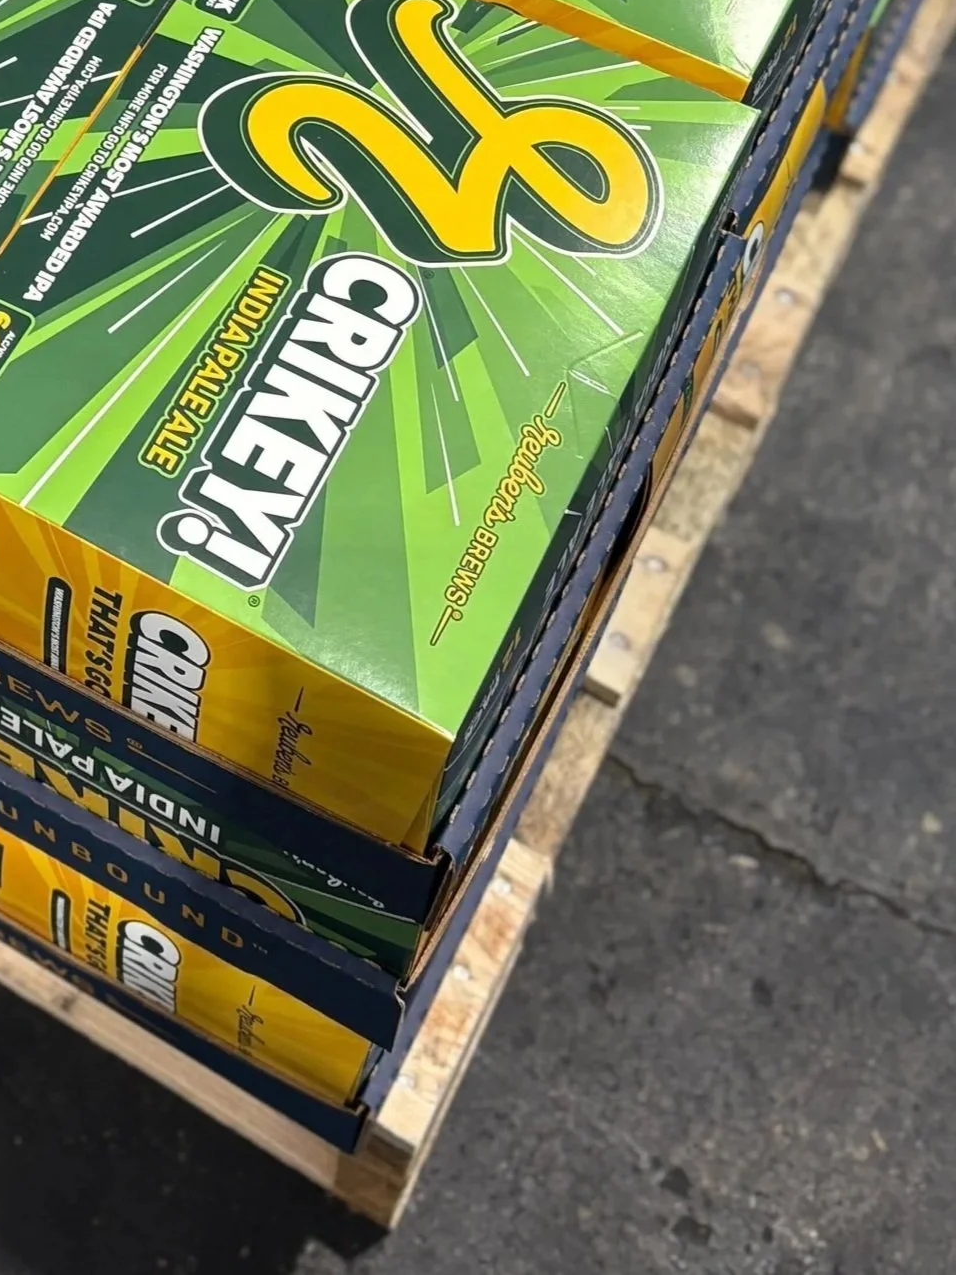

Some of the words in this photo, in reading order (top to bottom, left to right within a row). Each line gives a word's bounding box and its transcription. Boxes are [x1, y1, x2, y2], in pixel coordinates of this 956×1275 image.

[2, 100, 45, 152] MOST
[36, 26, 97, 106] AWARDED
[88, 2, 117, 30] IPA
[127, 83, 154, 111] MORE
[131, 27, 223, 148] WASHINGTON'S
[148, 63, 168, 86] FOR
[7, 156, 31, 186] INFO
[28, 139, 42, 159] GO
[37, 126, 52, 146] TO
[46, 56, 103, 130] CRIKEYIPA.COM
[94, 146, 110, 165] TO
[105, 132, 120, 151] GO
[113, 107, 137, 136] INFO
[40, 161, 99, 241] CRIKEYIPA.COM
[100, 142, 143, 192] MOST
[46, 187, 110, 273] AWARDED
[23, 270, 56, 301] IPA
[220, 270, 285, 346] INDIA
[178, 343, 241, 416] PALE
[145, 408, 196, 472] ALE
[167, 254, 420, 586] CRIKEY!
[445, 527, 498, 606] BREWS
[50, 587, 63, 638] WASHINGTON'S
[86, 586, 123, 675] THAT'S
[130, 612, 212, 743] CRIKE
[0, 705, 94, 775] PALE
[105, 766, 221, 846] INDIA
[122, 920, 181, 1014] CRIK
